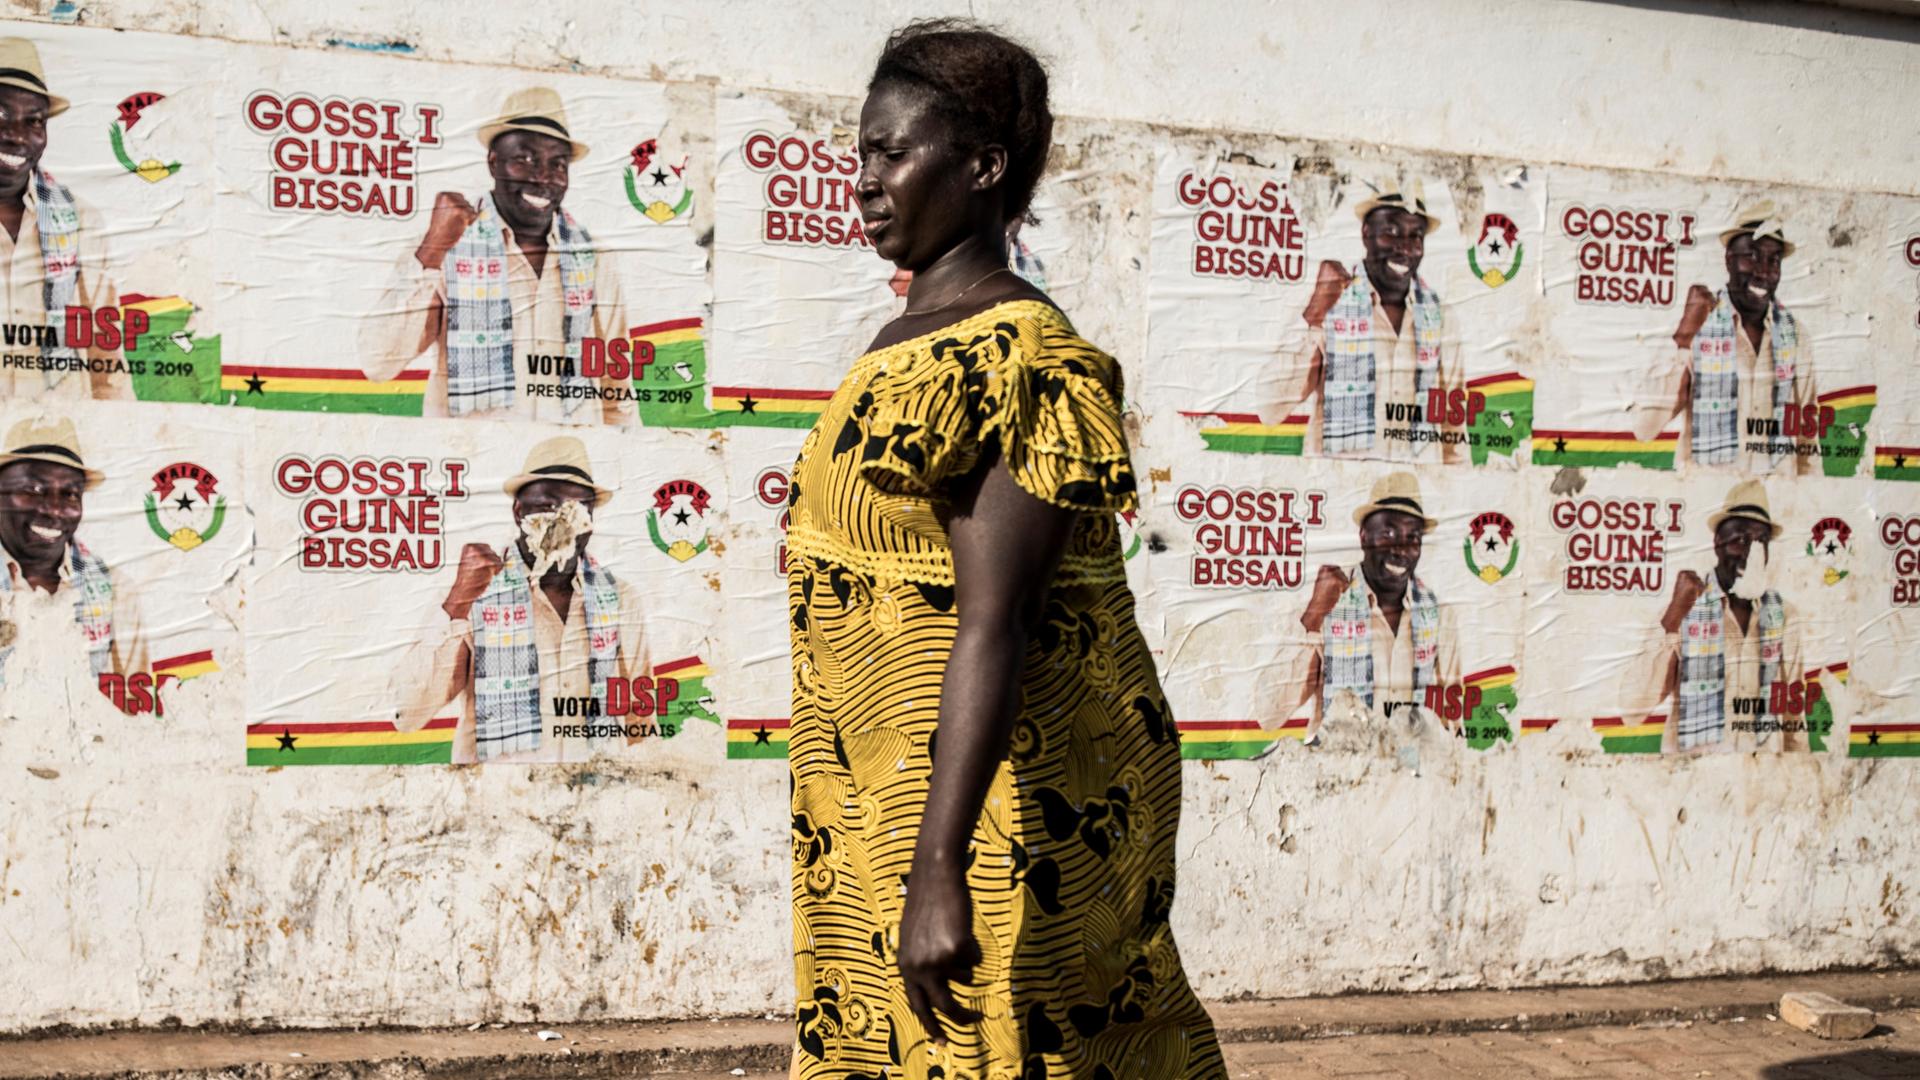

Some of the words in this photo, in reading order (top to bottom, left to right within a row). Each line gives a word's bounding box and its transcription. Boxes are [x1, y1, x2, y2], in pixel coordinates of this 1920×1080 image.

[249, 94, 400, 141] GOSSI
[274, 137, 413, 181] GUINÉ
[745, 134, 859, 175] GOSS
[273, 176, 413, 216] BISSAU
[767, 174, 863, 213] GUIN
[1563, 207, 1669, 243] GOSSI
[1195, 245, 1303, 281] BISSAU
[1580, 241, 1675, 276] GUINÉ
[1578, 274, 1673, 305] BISSAU
[2, 324, 59, 347] VOTA
[65, 306, 149, 351] DSP
[3, 355, 146, 375] PRESIDENCIAIS
[154, 361, 193, 377] 2019
[527, 354, 575, 377] VOTA
[581, 337, 655, 380] DSP
[527, 384, 650, 401] PRESIDENCIAIS
[658, 389, 693, 404] 2019
[1385, 403, 1422, 422] VOTA
[1427, 388, 1486, 427] DSP
[1384, 428, 1480, 445] PRESIDENCIAIS
[1486, 434, 1513, 447] 2019
[1747, 418, 1779, 436] VOTA
[1783, 403, 1835, 439] DSP
[1836, 446, 1860, 458] 2019
[278, 458, 427, 497] GOSSI
[304, 495, 440, 535] GUINÉ
[1177, 488, 1295, 523] GOSSI
[1553, 500, 1656, 531] GOSSI
[303, 537, 440, 569] BISSAU
[1196, 522, 1303, 556] GUINÉ
[1568, 530, 1664, 562] GUINÉ
[1194, 558, 1302, 587] BISSAU
[1567, 566, 1662, 591] BISSAU
[553, 697, 600, 717] VOTA
[606, 676, 679, 717] DSP
[1733, 697, 1765, 714] VOTA
[1769, 680, 1822, 715] DSP
[553, 725, 676, 738] PRESIDENCIAIS
[1482, 726, 1509, 739] 2019
